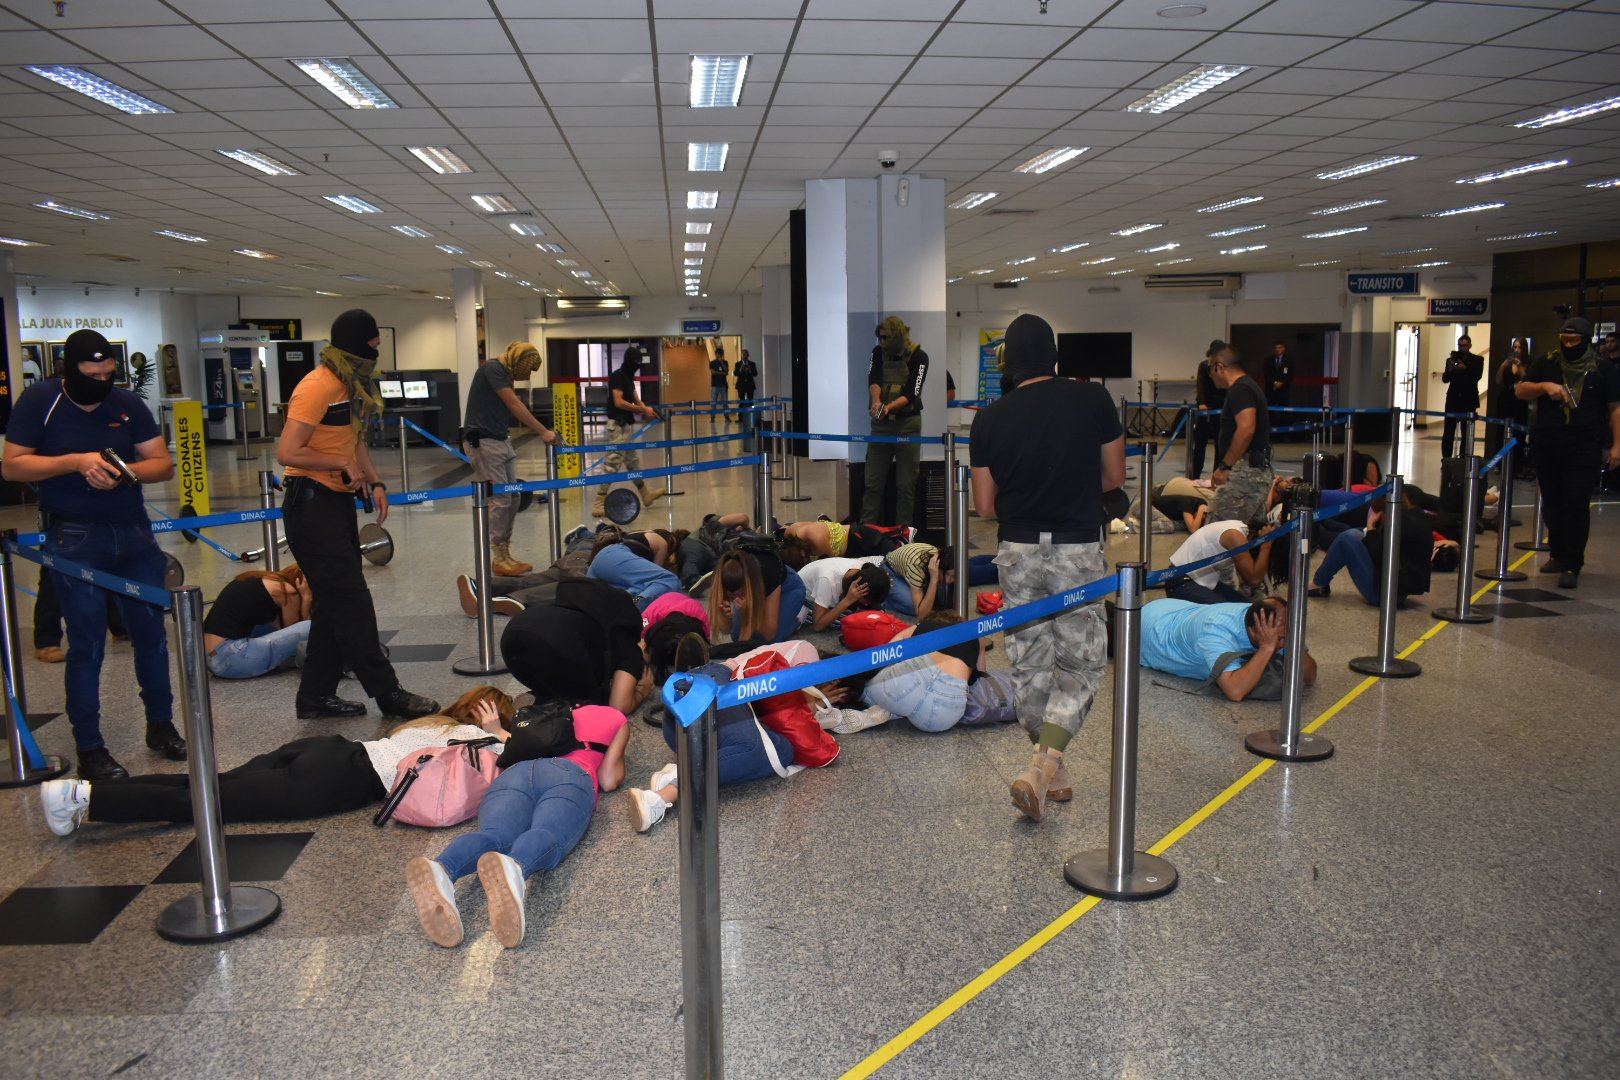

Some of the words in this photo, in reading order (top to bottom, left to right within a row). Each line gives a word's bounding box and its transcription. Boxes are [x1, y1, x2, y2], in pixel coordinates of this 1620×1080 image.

[1357, 277, 1404, 290] TRANSITO
[1475, 303, 1483, 312] 4
[19, 318, 38, 329] LA
[40, 318, 73, 329] JUAN
[75, 318, 113, 329] PABLO
[116, 318, 123, 329] II
[712, 322, 718, 330] 3
[191, 432, 205, 493] CITIZENS
[407, 492, 428, 501] DINAC
[504, 484, 523, 492] DINAC
[569, 478, 586, 486] DINAC
[680, 465, 696, 473] DINAC
[151, 521, 173, 531] INAC
[241, 510, 266, 521] DINAC
[737, 676, 778, 700] DINAC
[871, 644, 904, 665] DINAC
[978, 616, 1004, 634] DINAC
[1063, 589, 1086, 607] DINAC
